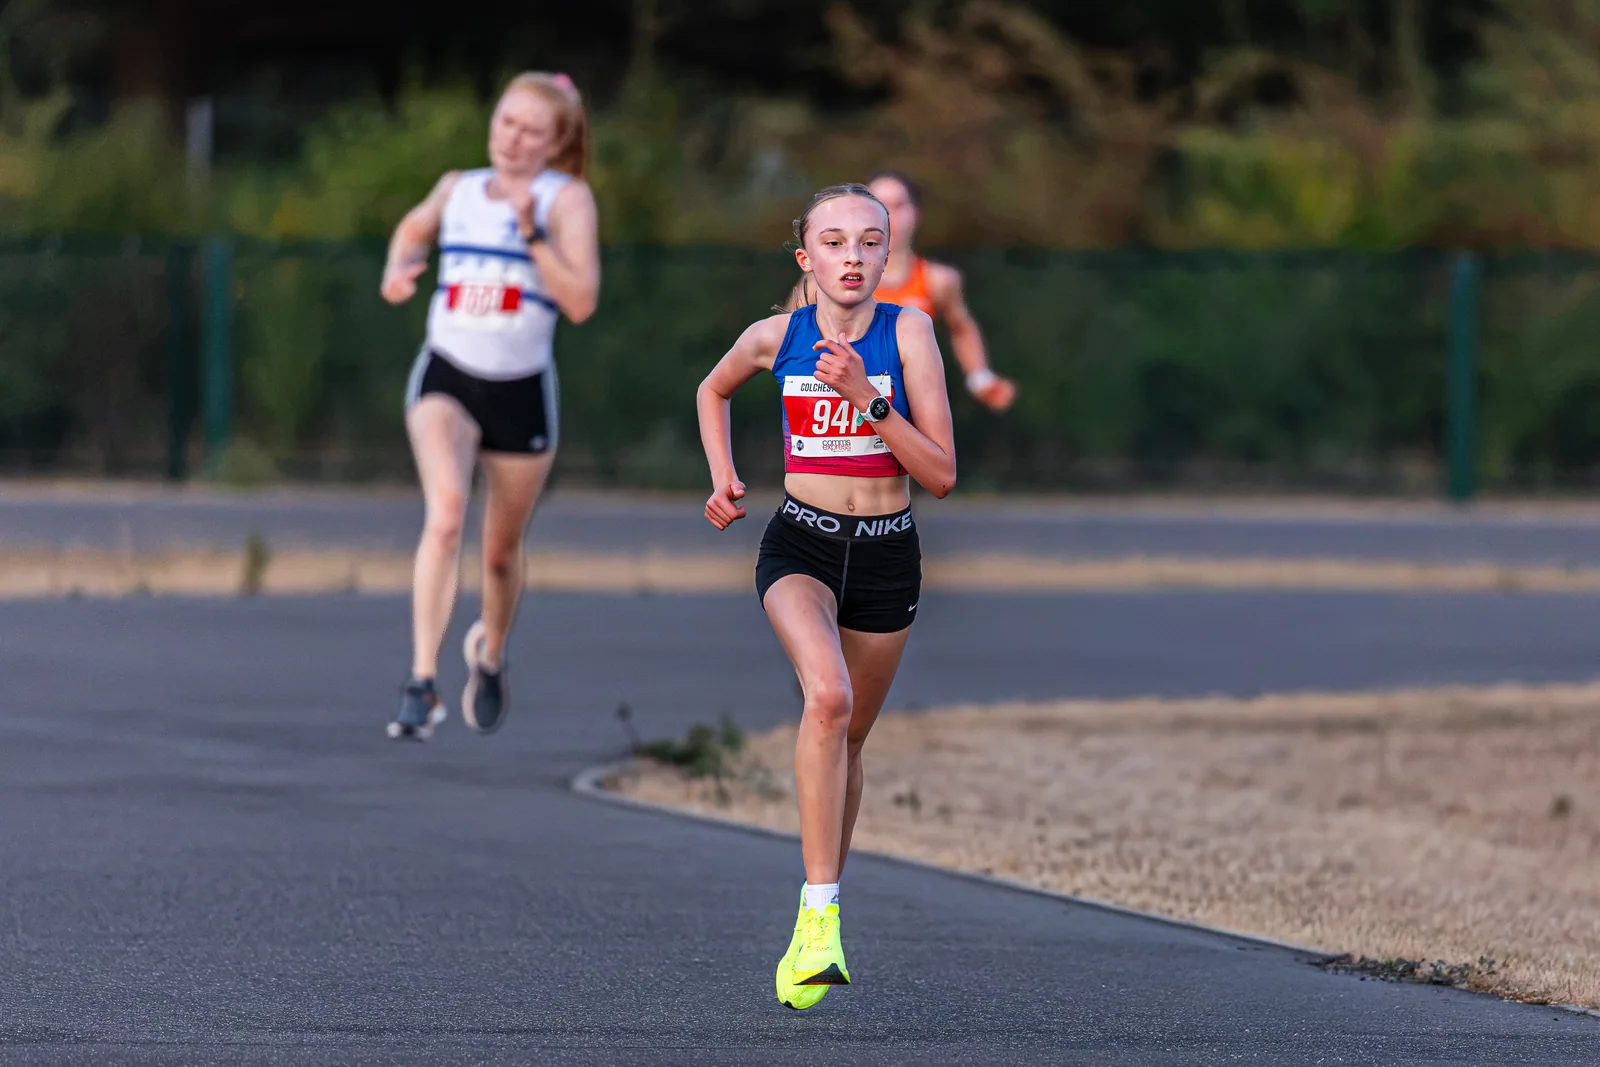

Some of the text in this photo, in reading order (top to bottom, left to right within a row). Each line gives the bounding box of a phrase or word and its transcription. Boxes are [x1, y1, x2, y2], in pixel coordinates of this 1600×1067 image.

[800, 382, 834, 392] COLCHES
[782, 500, 912, 537] PRO NIKE
